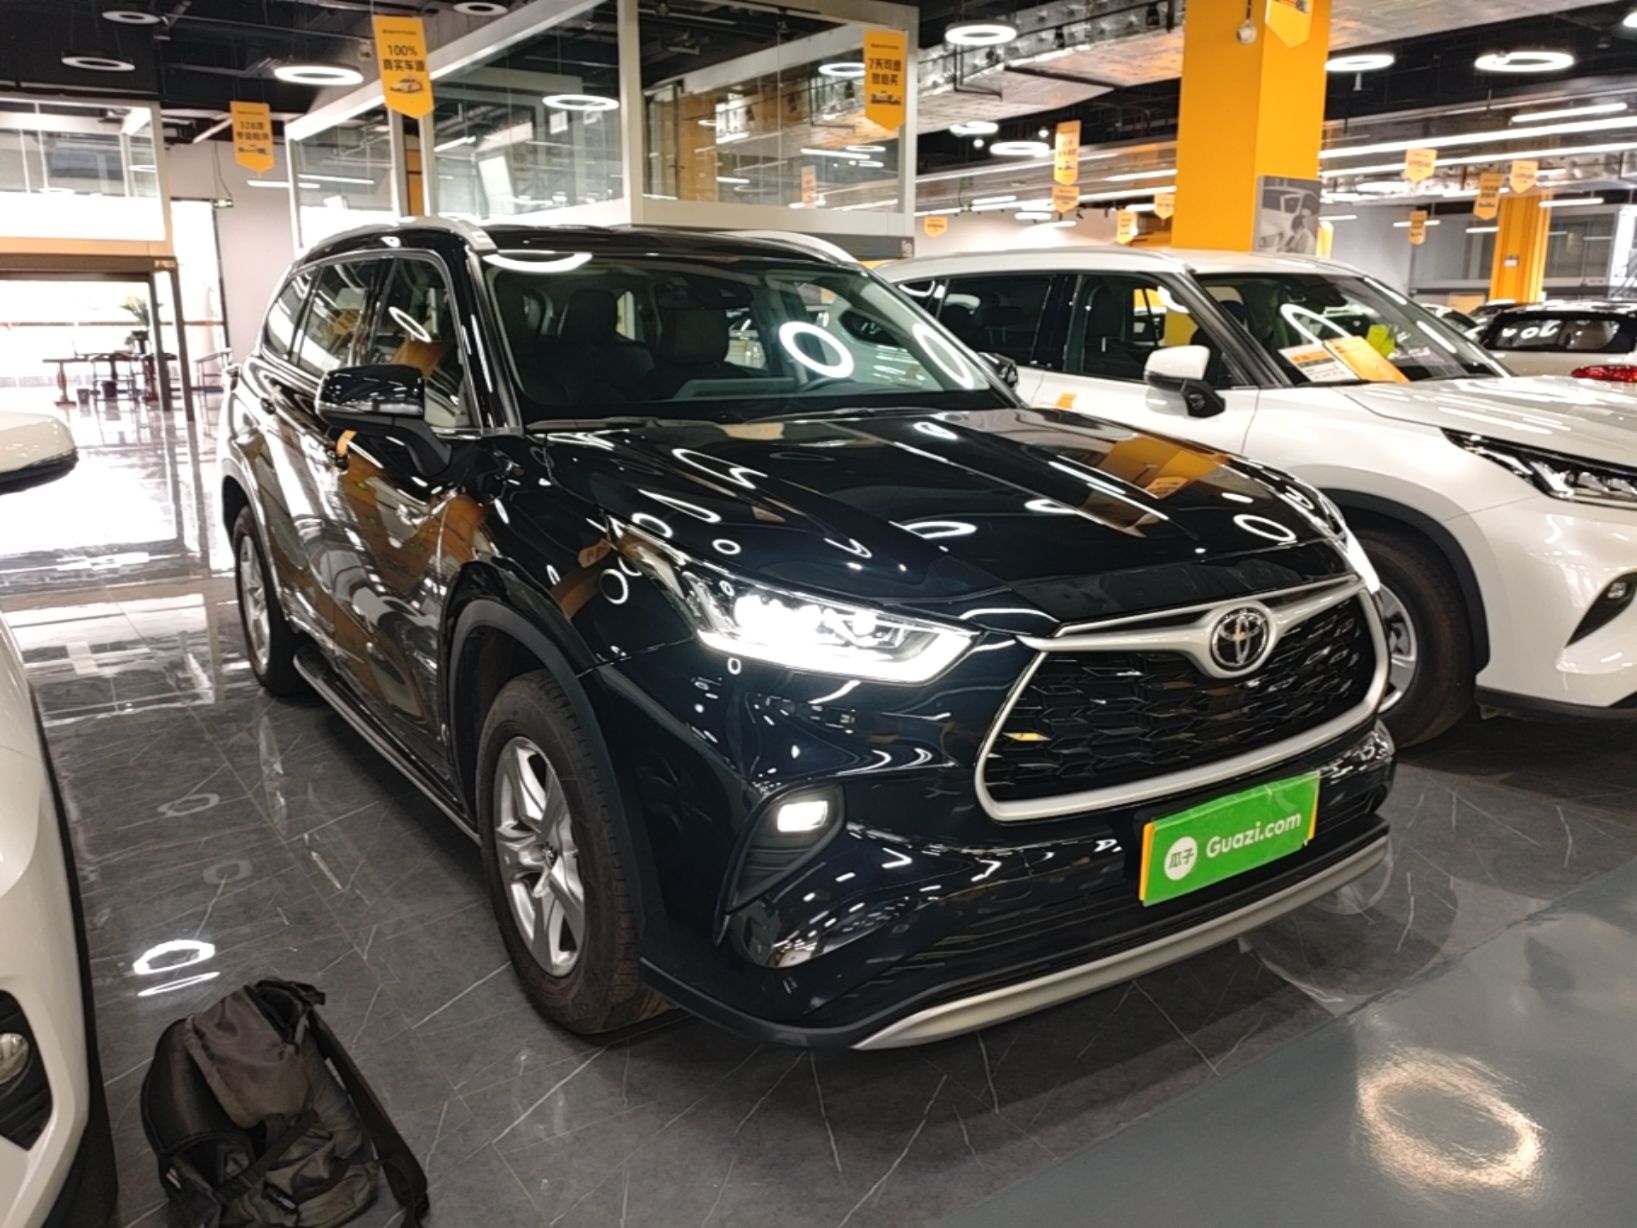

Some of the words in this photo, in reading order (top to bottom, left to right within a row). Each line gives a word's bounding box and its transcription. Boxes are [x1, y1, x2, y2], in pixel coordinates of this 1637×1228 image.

[387, 44, 418, 56] 100%
[1206, 813, 1302, 859] Guazi.com
[1168, 848, 1195, 869] 瓜子
